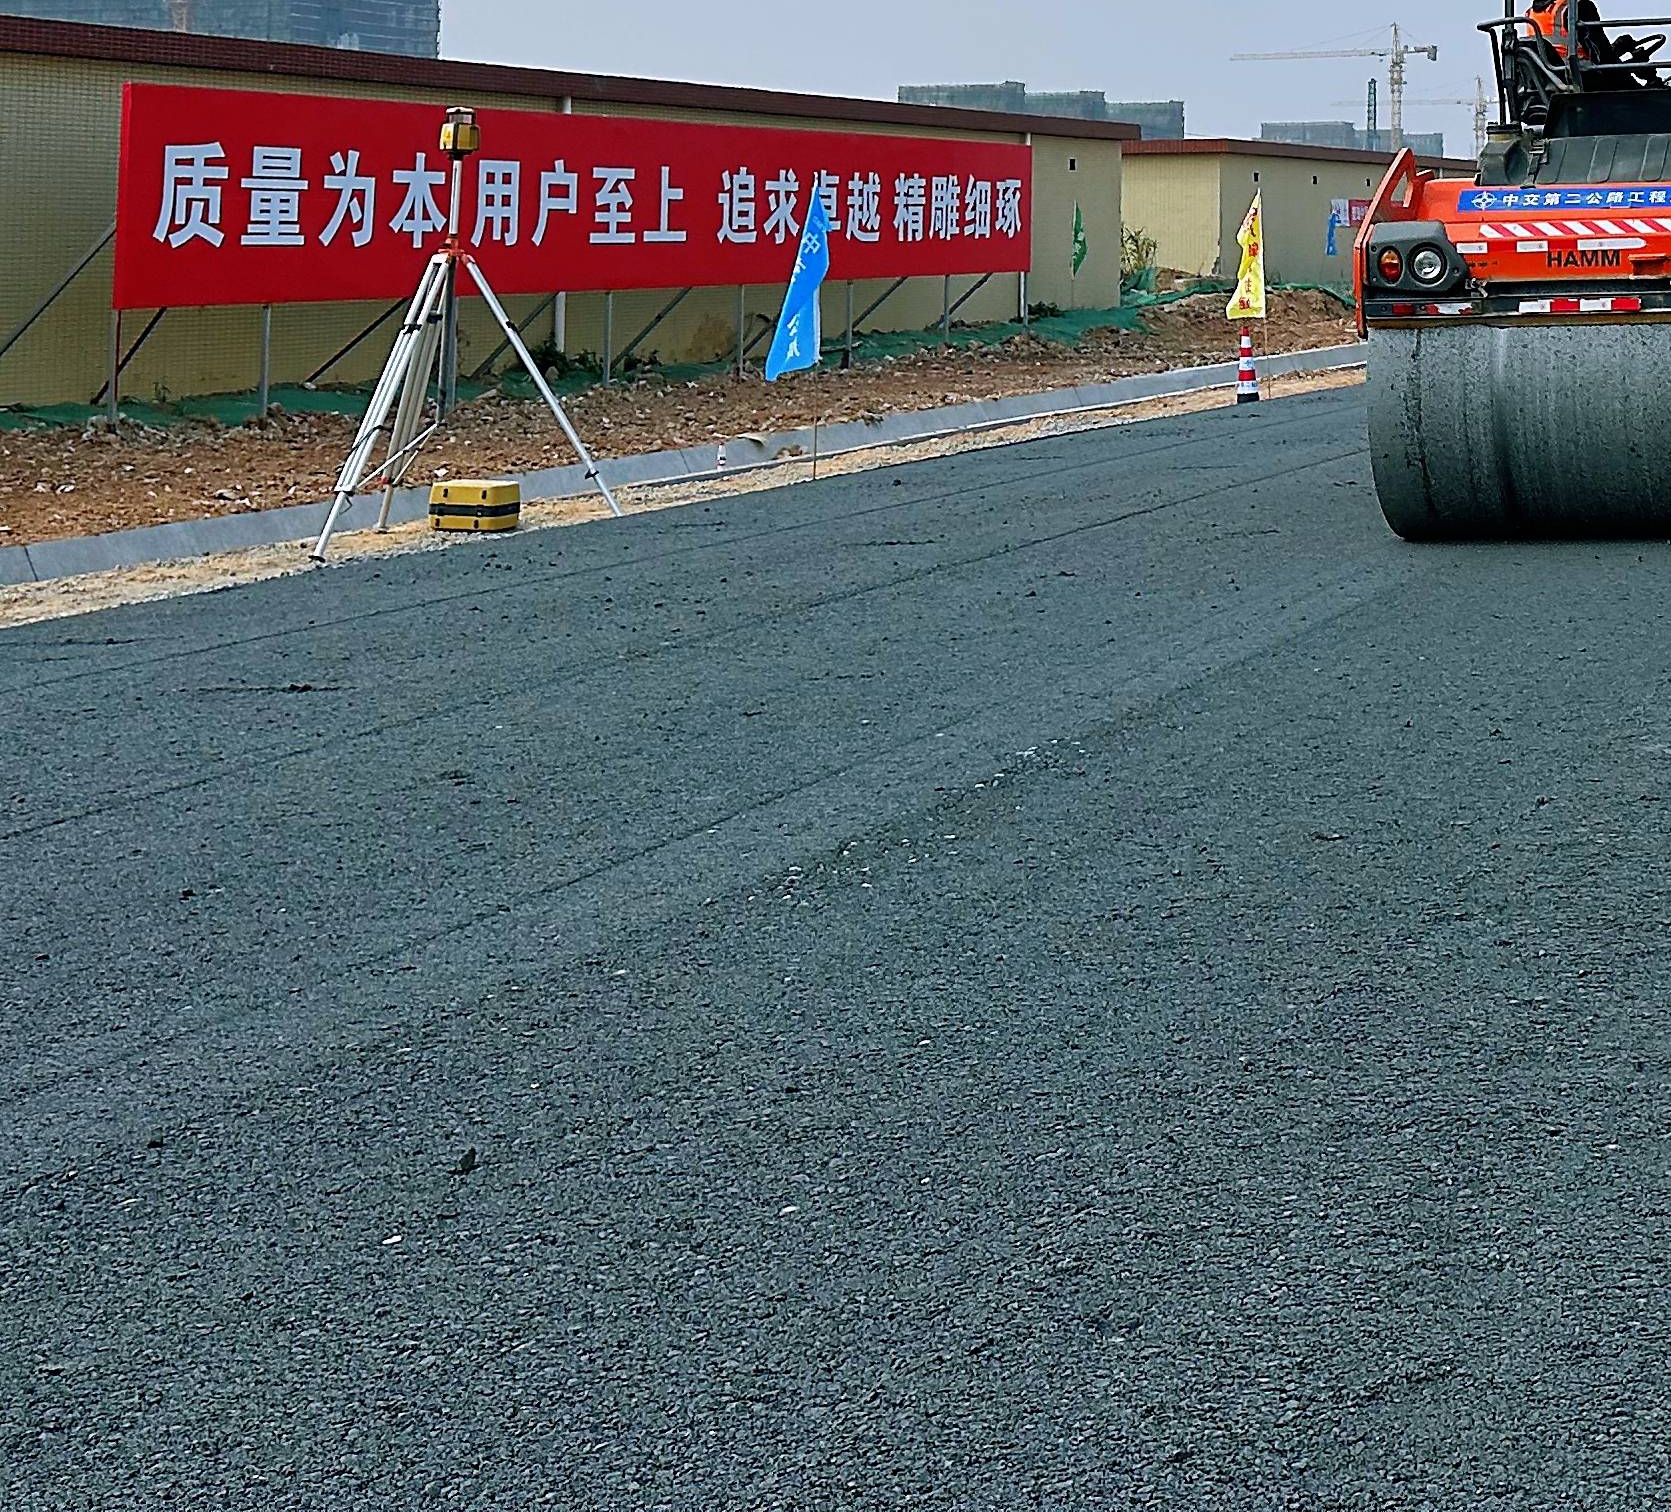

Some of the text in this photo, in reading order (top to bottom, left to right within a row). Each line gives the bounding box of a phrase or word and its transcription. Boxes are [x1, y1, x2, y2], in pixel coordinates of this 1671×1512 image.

[152, 141, 1022, 248] 质量为本 用户至上 追求卓越 精雕细琢
[1547, 249, 1621, 268] HAMM
